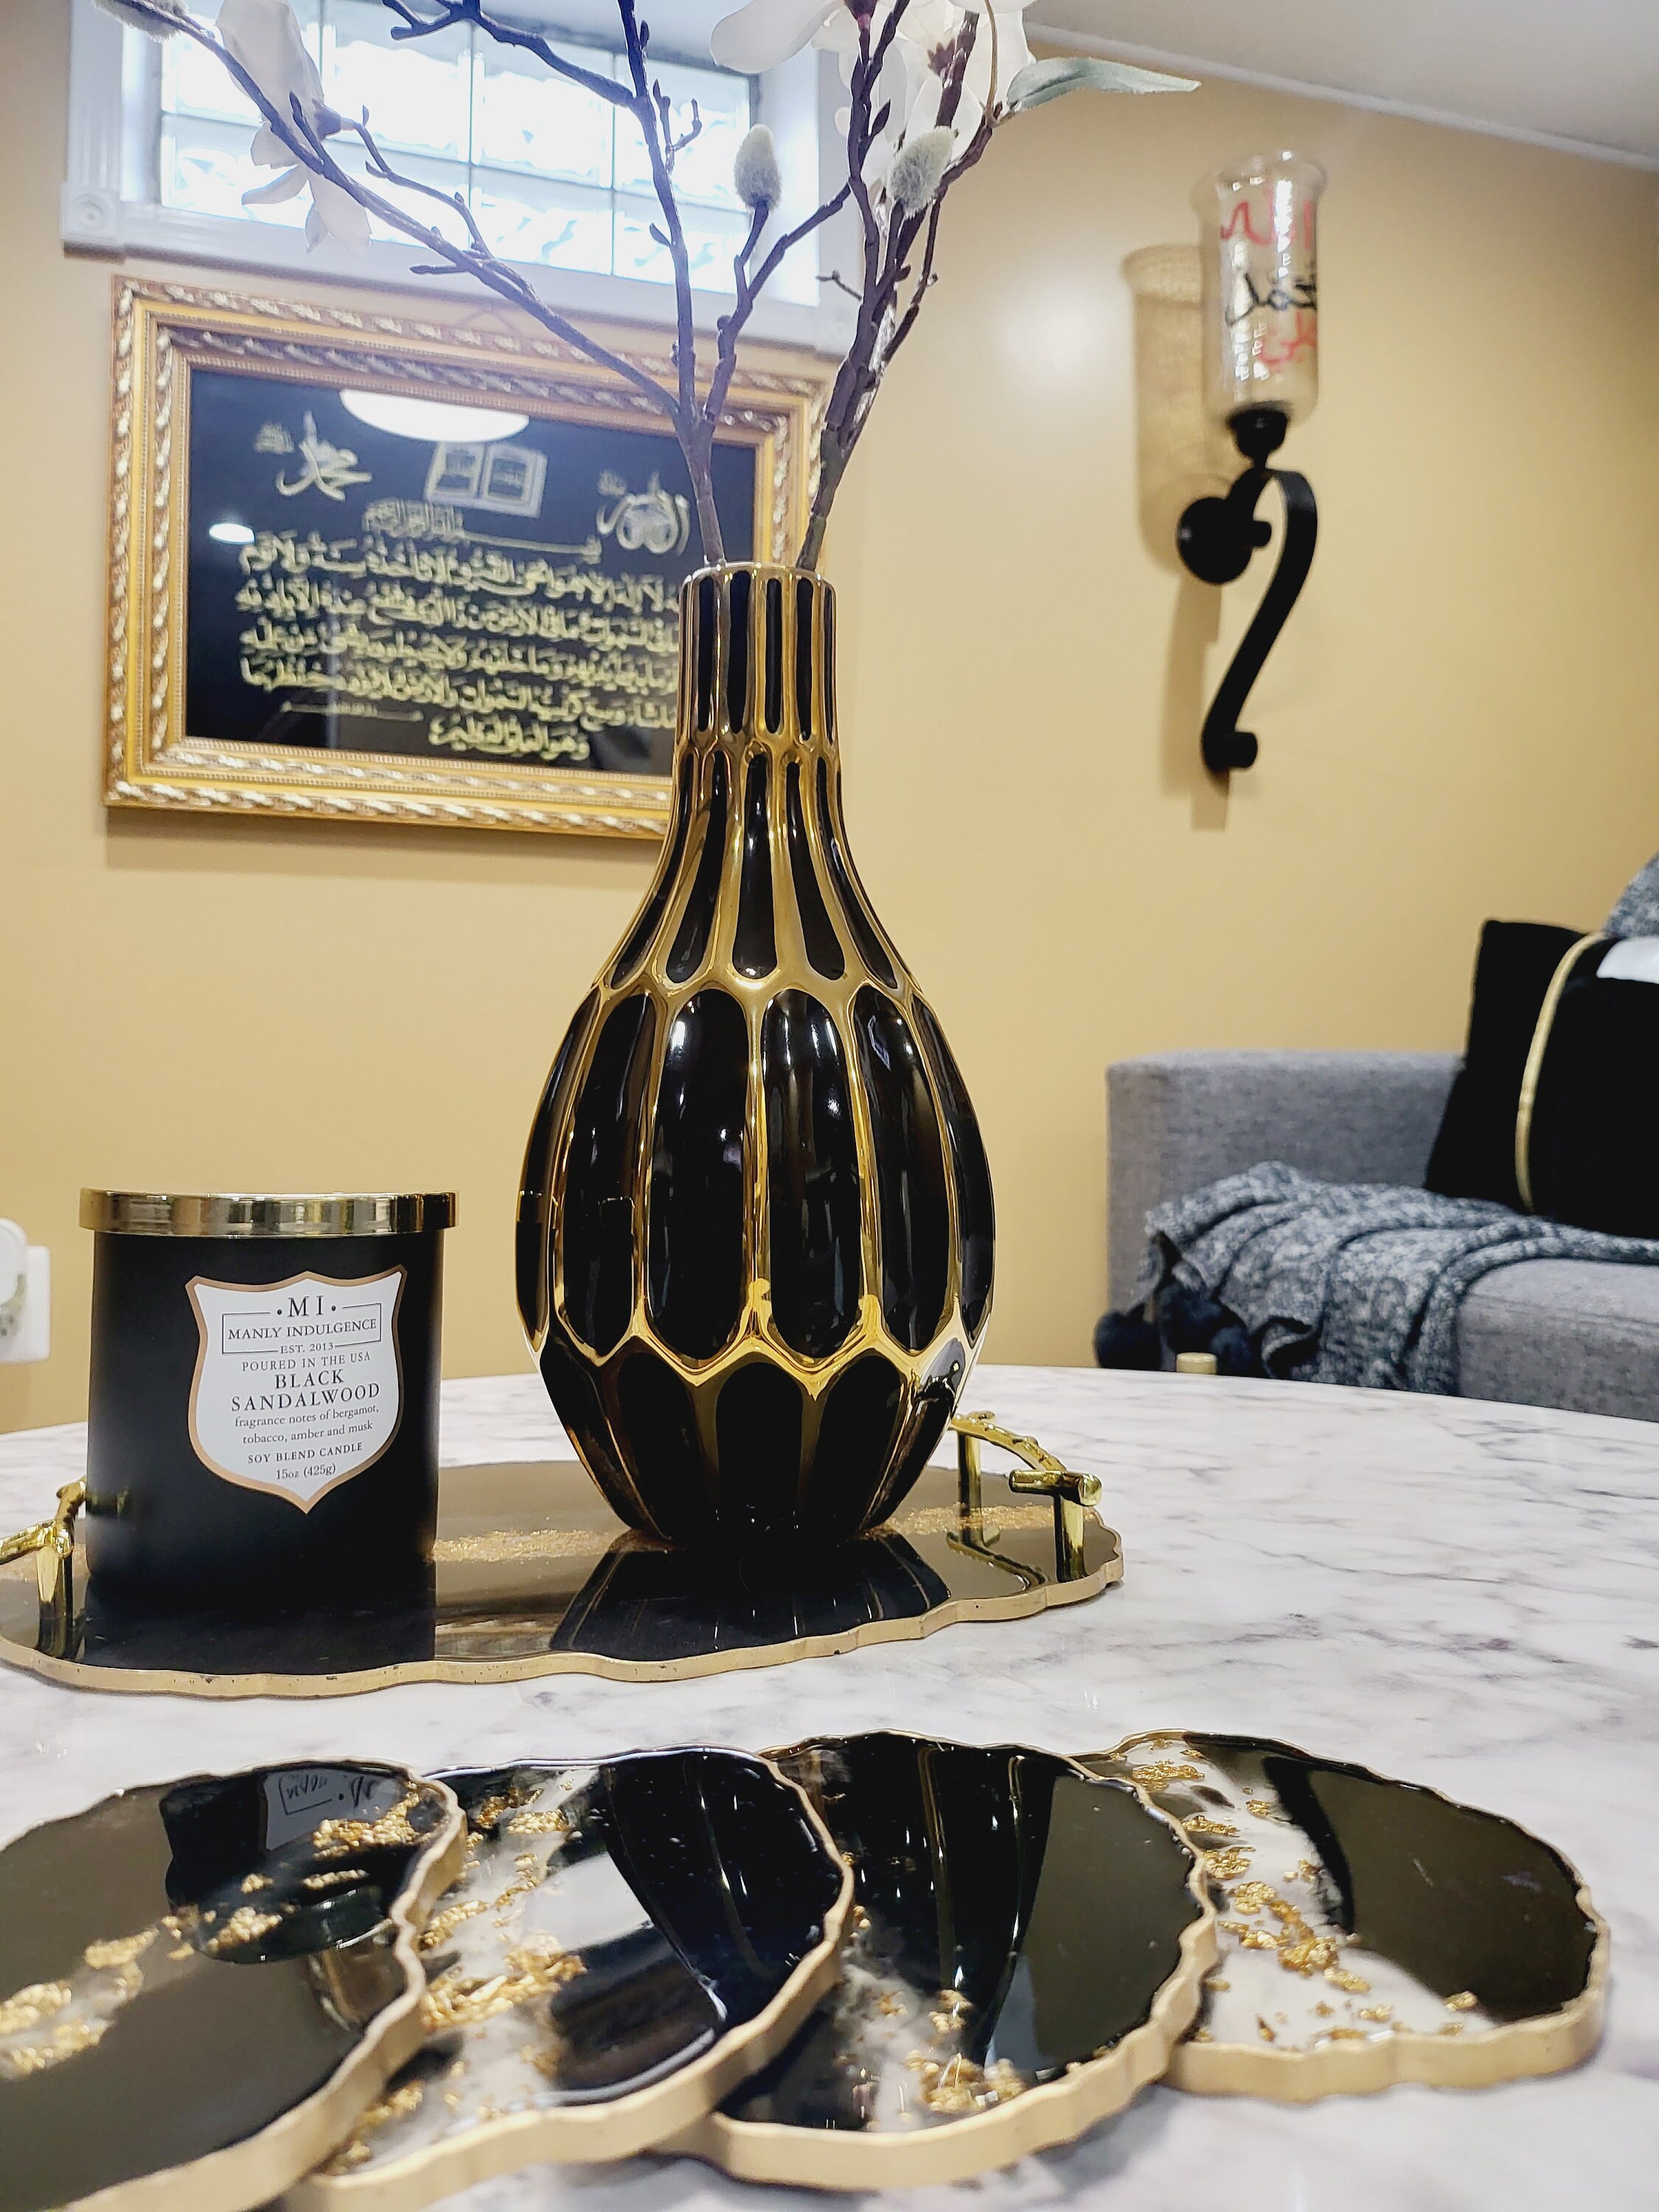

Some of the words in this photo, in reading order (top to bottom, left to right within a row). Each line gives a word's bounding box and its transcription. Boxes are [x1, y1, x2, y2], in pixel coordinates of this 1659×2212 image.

[228, 1326, 282, 1340] MANLY
[287, 1318, 377, 1338] INDULGENCE
[280, 1344, 306, 1354] EST.
[310, 1341, 334, 1352] 2013
[242, 1359, 296, 1372] POURED
[302, 1357, 316, 1368] IN
[321, 1354, 345, 1366] THE
[350, 1351, 370, 1363] USA
[275, 1368, 345, 1389] BLACK
[231, 1383, 380, 1411] SANDALWOOD
[234, 1416, 285, 1427] fragrance
[288, 1413, 316, 1424] notes
[319, 1410, 330, 1421] of
[333, 1405, 379, 1419] bergamot,
[243, 1432, 288, 1444] tobacco,
[291, 1428, 324, 1441] amber
[327, 1425, 346, 1436] and
[348, 1420, 373, 1434] musk
[248, 1453, 271, 1464] SOY
[275, 1449, 316, 1462] BLEND
[319, 1442, 363, 1457] CANDLE
[276, 1467, 299, 1481] 15oz
[304, 1462, 336, 1478] (425g)
